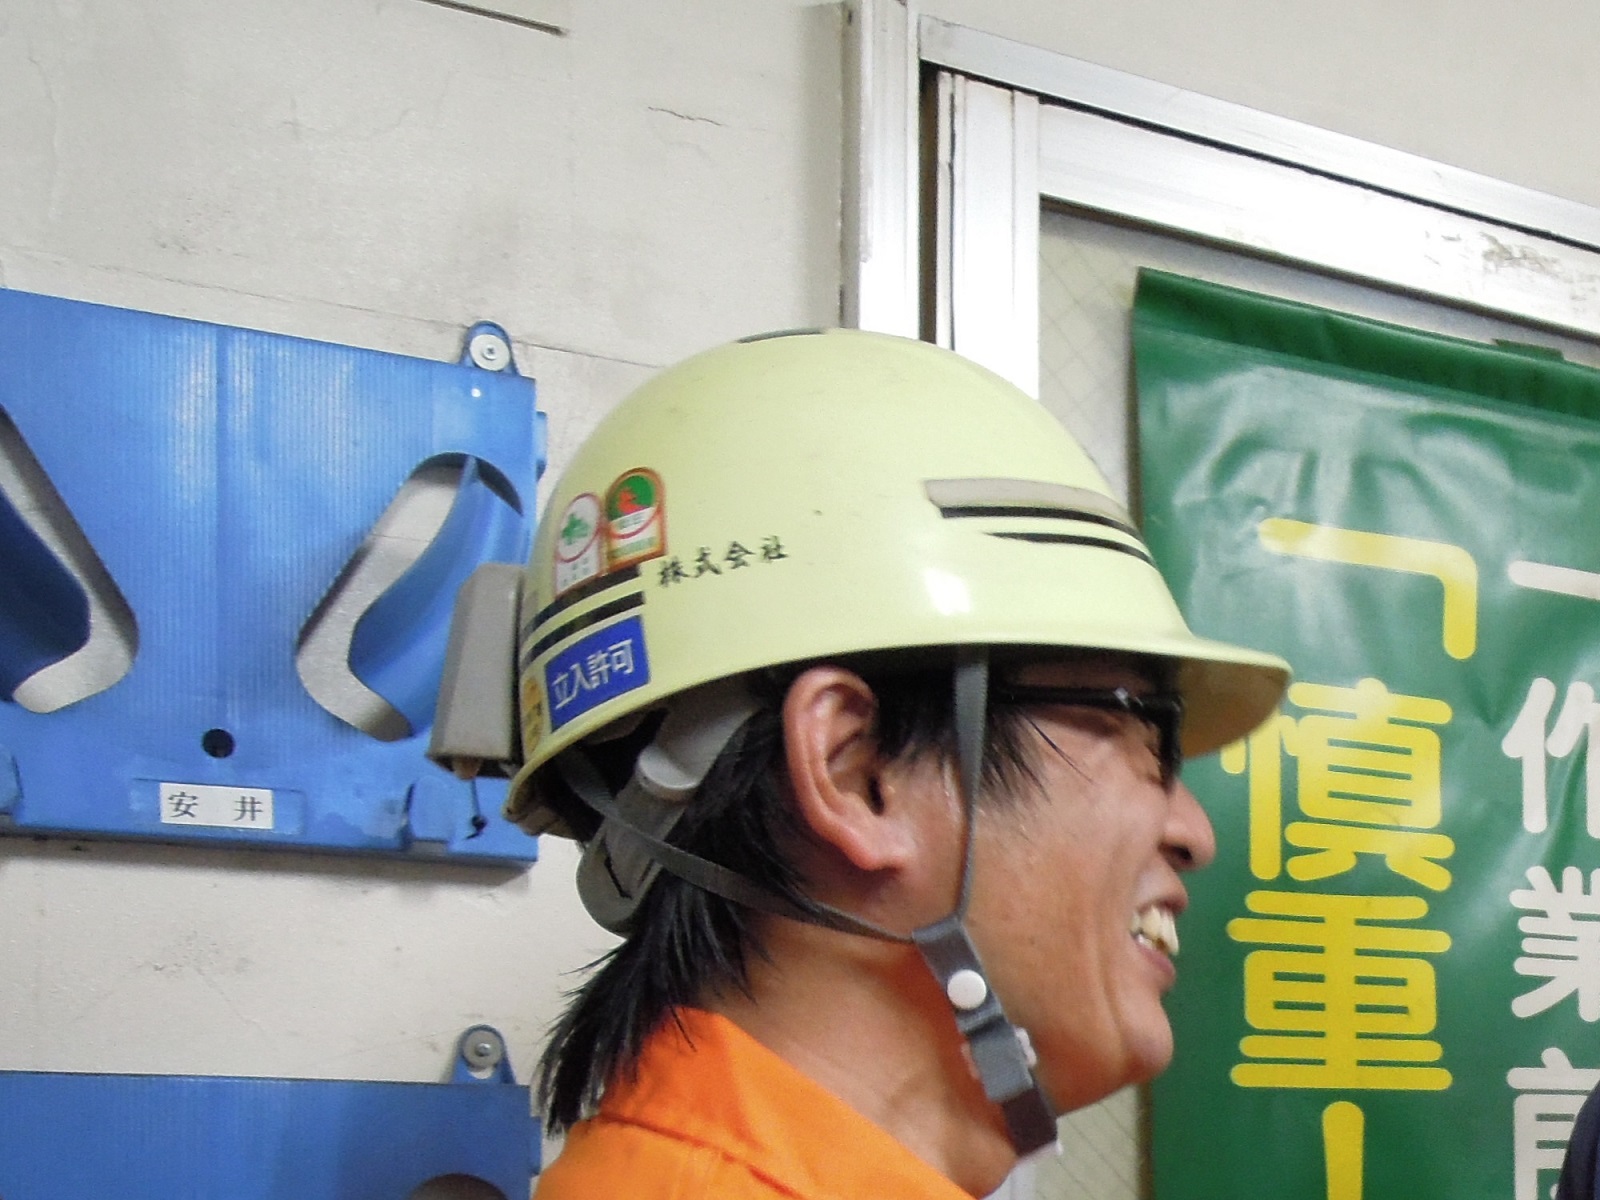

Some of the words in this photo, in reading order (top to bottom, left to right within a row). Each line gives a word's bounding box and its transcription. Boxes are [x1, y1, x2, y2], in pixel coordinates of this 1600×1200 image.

[657, 535, 791, 588] 株式会社
[552, 638, 636, 711] 立入許可
[168, 791, 264, 822] 安井
